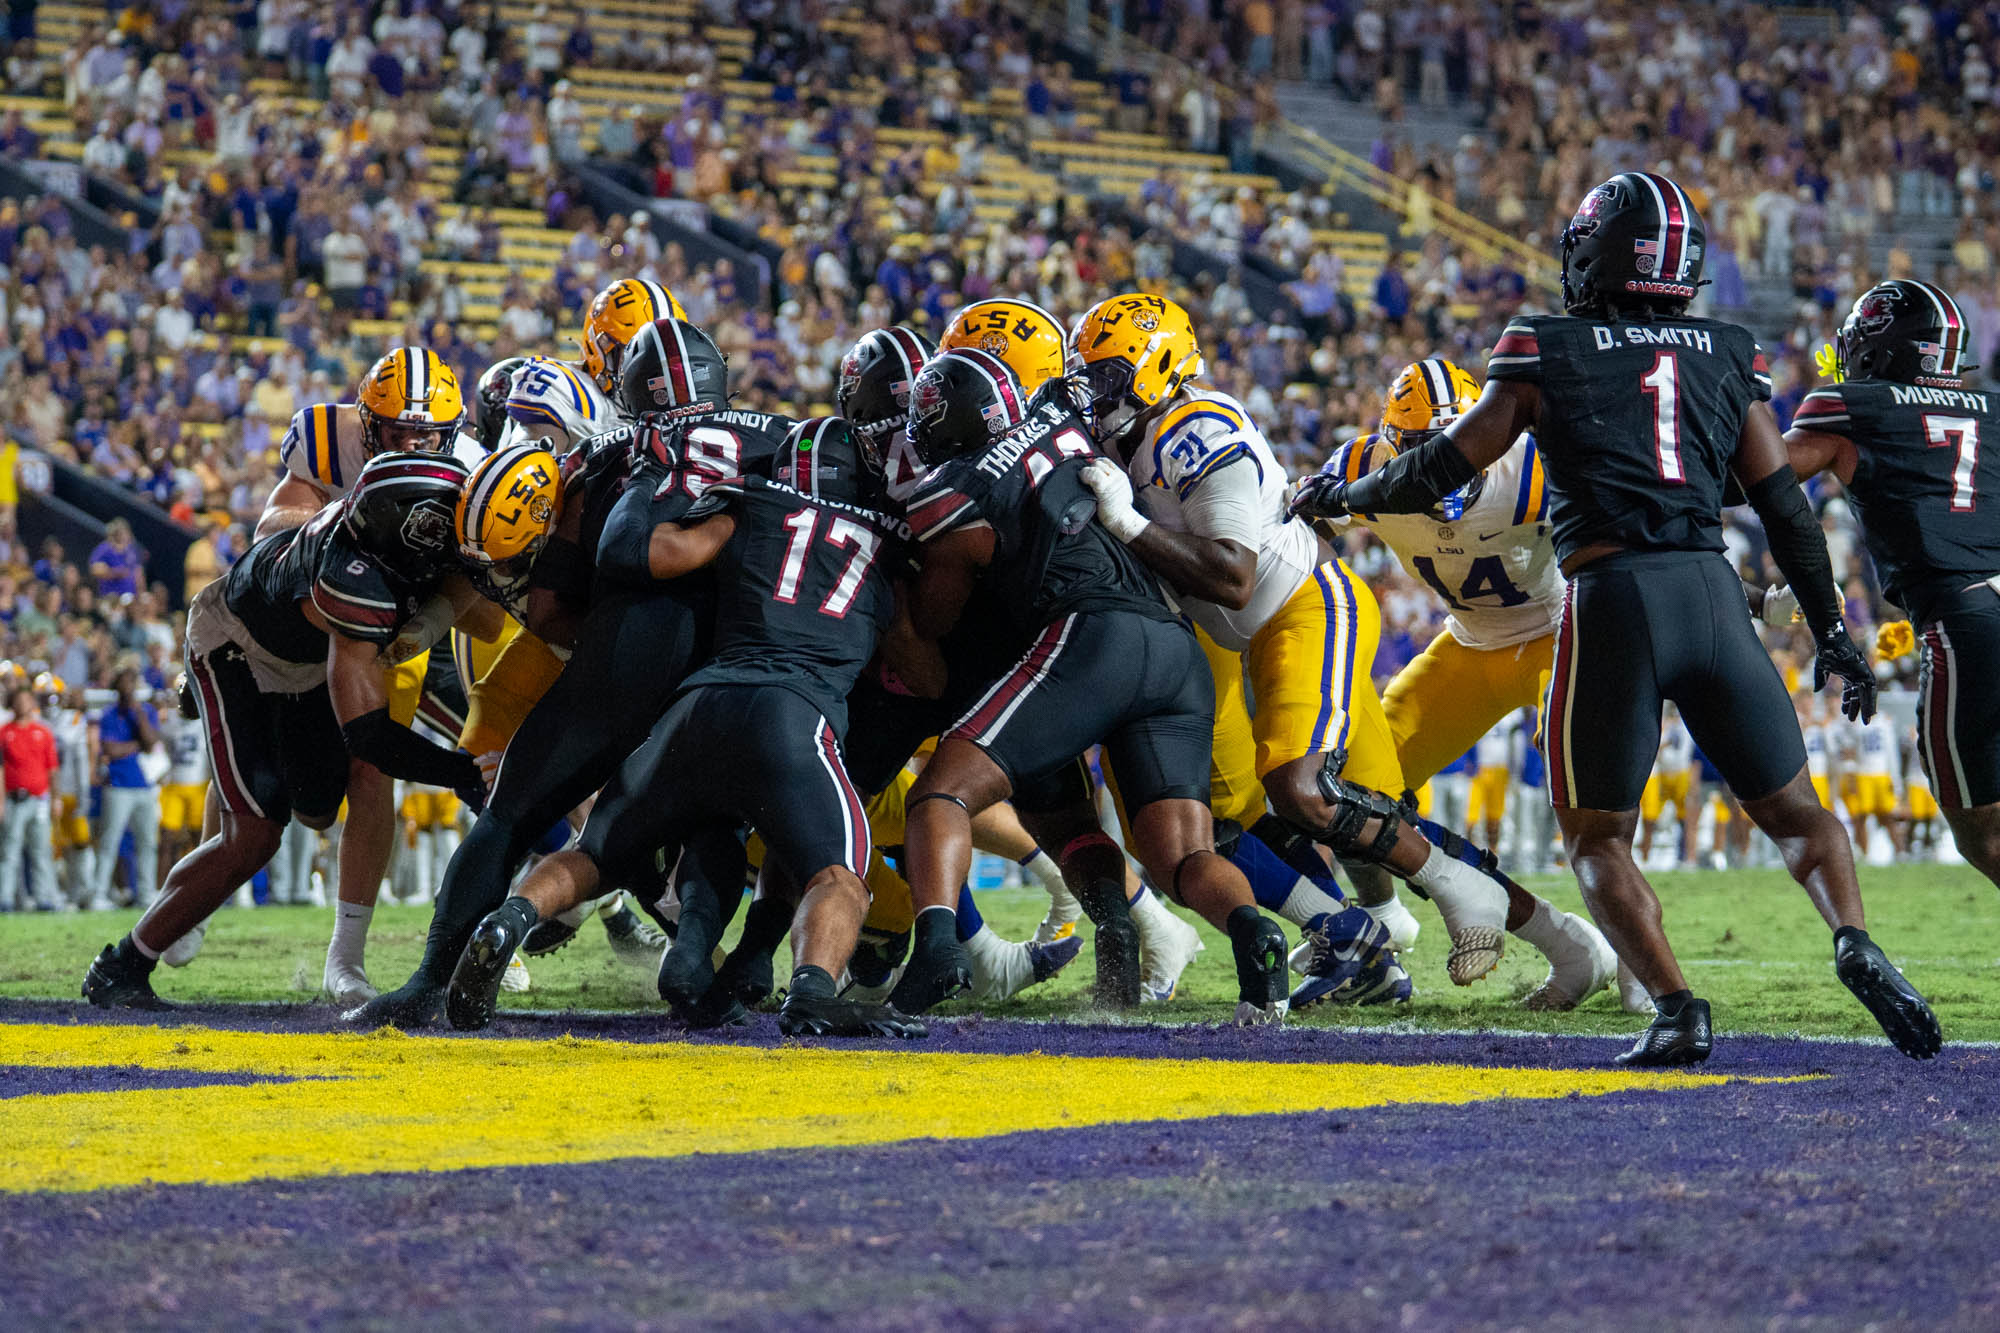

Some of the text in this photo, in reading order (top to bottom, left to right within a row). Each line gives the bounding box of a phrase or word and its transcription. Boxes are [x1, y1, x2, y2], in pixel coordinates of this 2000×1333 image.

[1592, 326, 1713, 354] D. SMITH
[1641, 351, 1687, 485] 1
[1889, 386, 1988, 413] MURPHY
[975, 417, 1051, 480] THOMAS
[1921, 412, 1981, 513] 7
[774, 503, 884, 619] 17
[1412, 555, 1531, 612] 14
